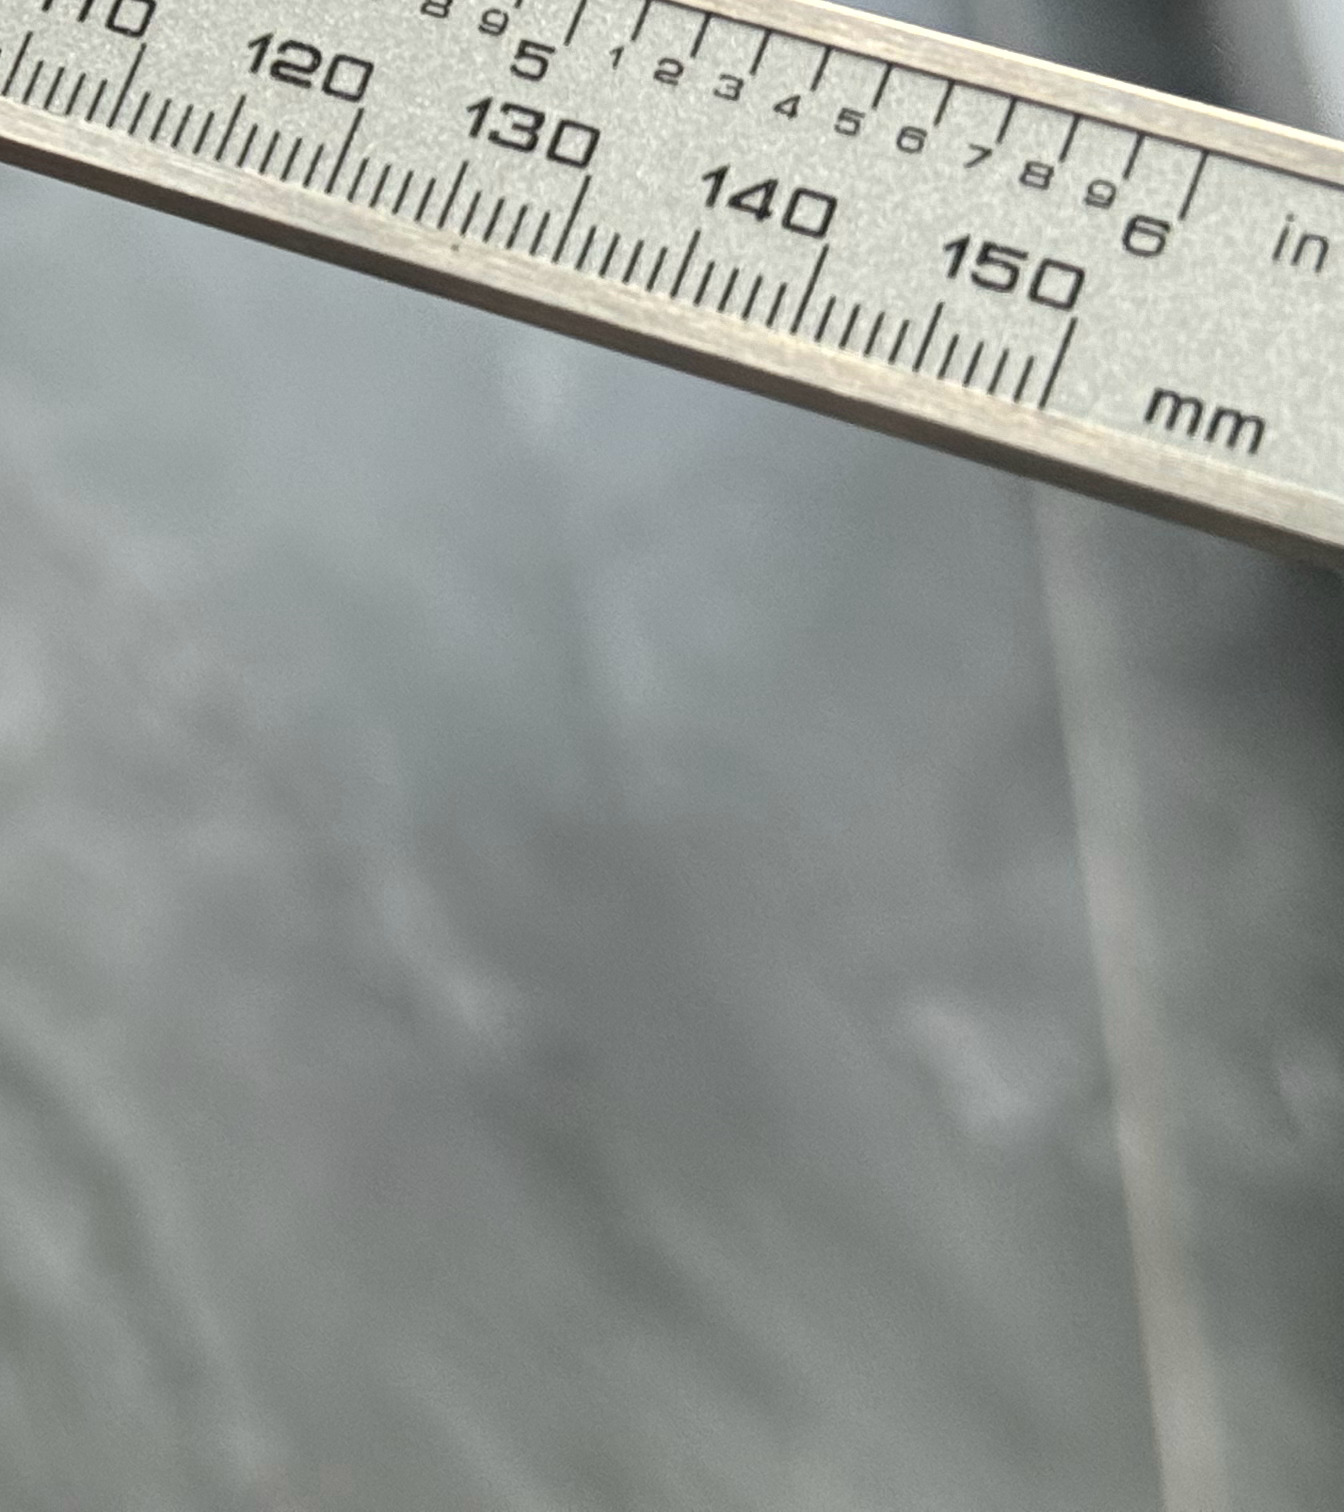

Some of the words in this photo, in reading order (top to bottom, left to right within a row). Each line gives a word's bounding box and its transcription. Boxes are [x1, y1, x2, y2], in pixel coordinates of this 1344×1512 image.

[247, 32, 375, 104] 120
[466, 97, 601, 170] 130
[701, 165, 838, 240] 140
[943, 234, 1086, 313] 150
[1143, 387, 1266, 456] mm
[477, 7, 510, 38] 9
[509, 39, 556, 83] 5
[609, 45, 625, 70] 1
[653, 57, 685, 87] 2
[712, 73, 745, 102] 3
[772, 94, 802, 120] 4
[834, 107, 866, 138] 5
[895, 125, 928, 155] 6
[964, 143, 994, 169] 7
[1018, 160, 1055, 191] 8
[1083, 178, 1118, 210] 9
[1121, 214, 1172, 259] 6
[1272, 213, 1330, 274] in
